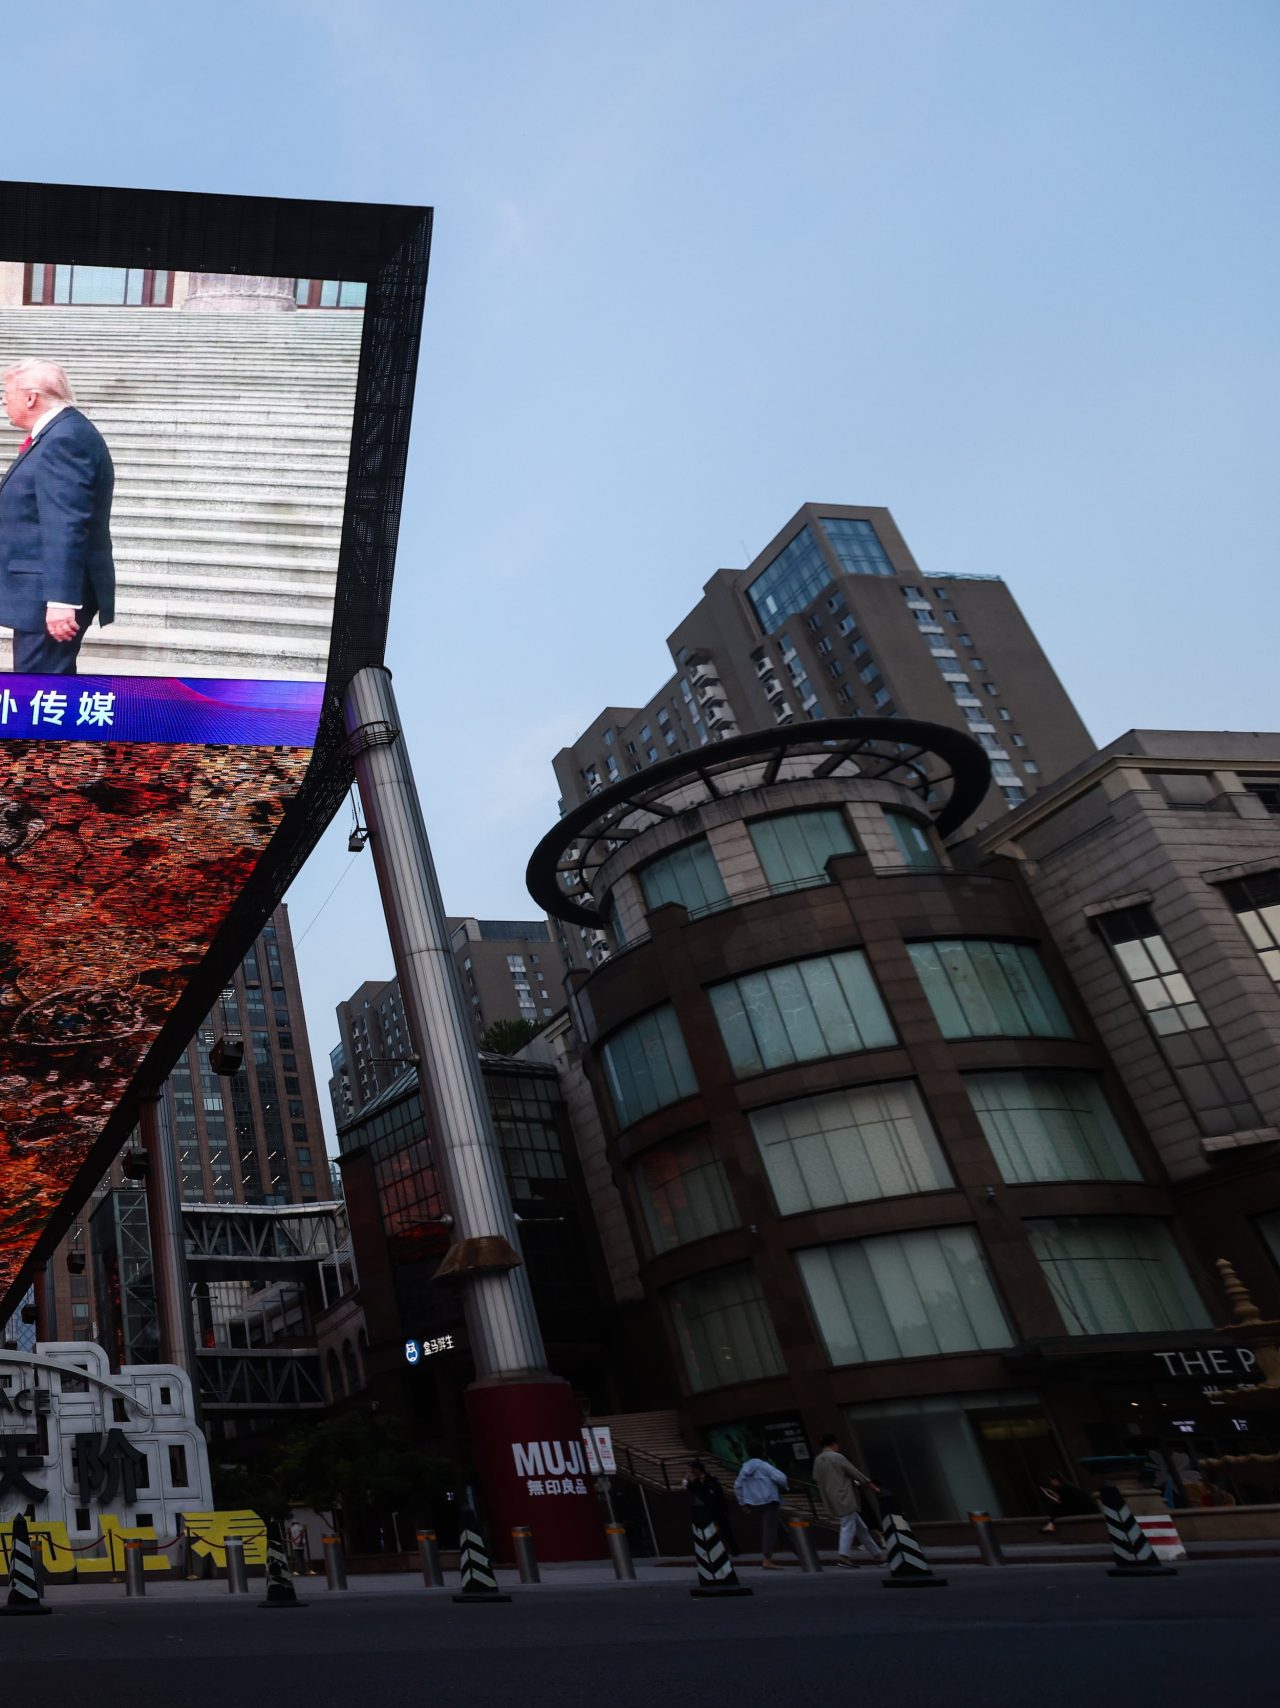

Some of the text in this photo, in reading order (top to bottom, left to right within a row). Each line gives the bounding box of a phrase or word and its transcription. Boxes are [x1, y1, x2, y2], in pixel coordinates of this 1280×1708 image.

[423, 1334, 455, 1356] 盒马鲜生
[1153, 1349, 1233, 1377] THE
[511, 1440, 587, 1477] MUJI
[526, 1477, 588, 1496] 無印良品
